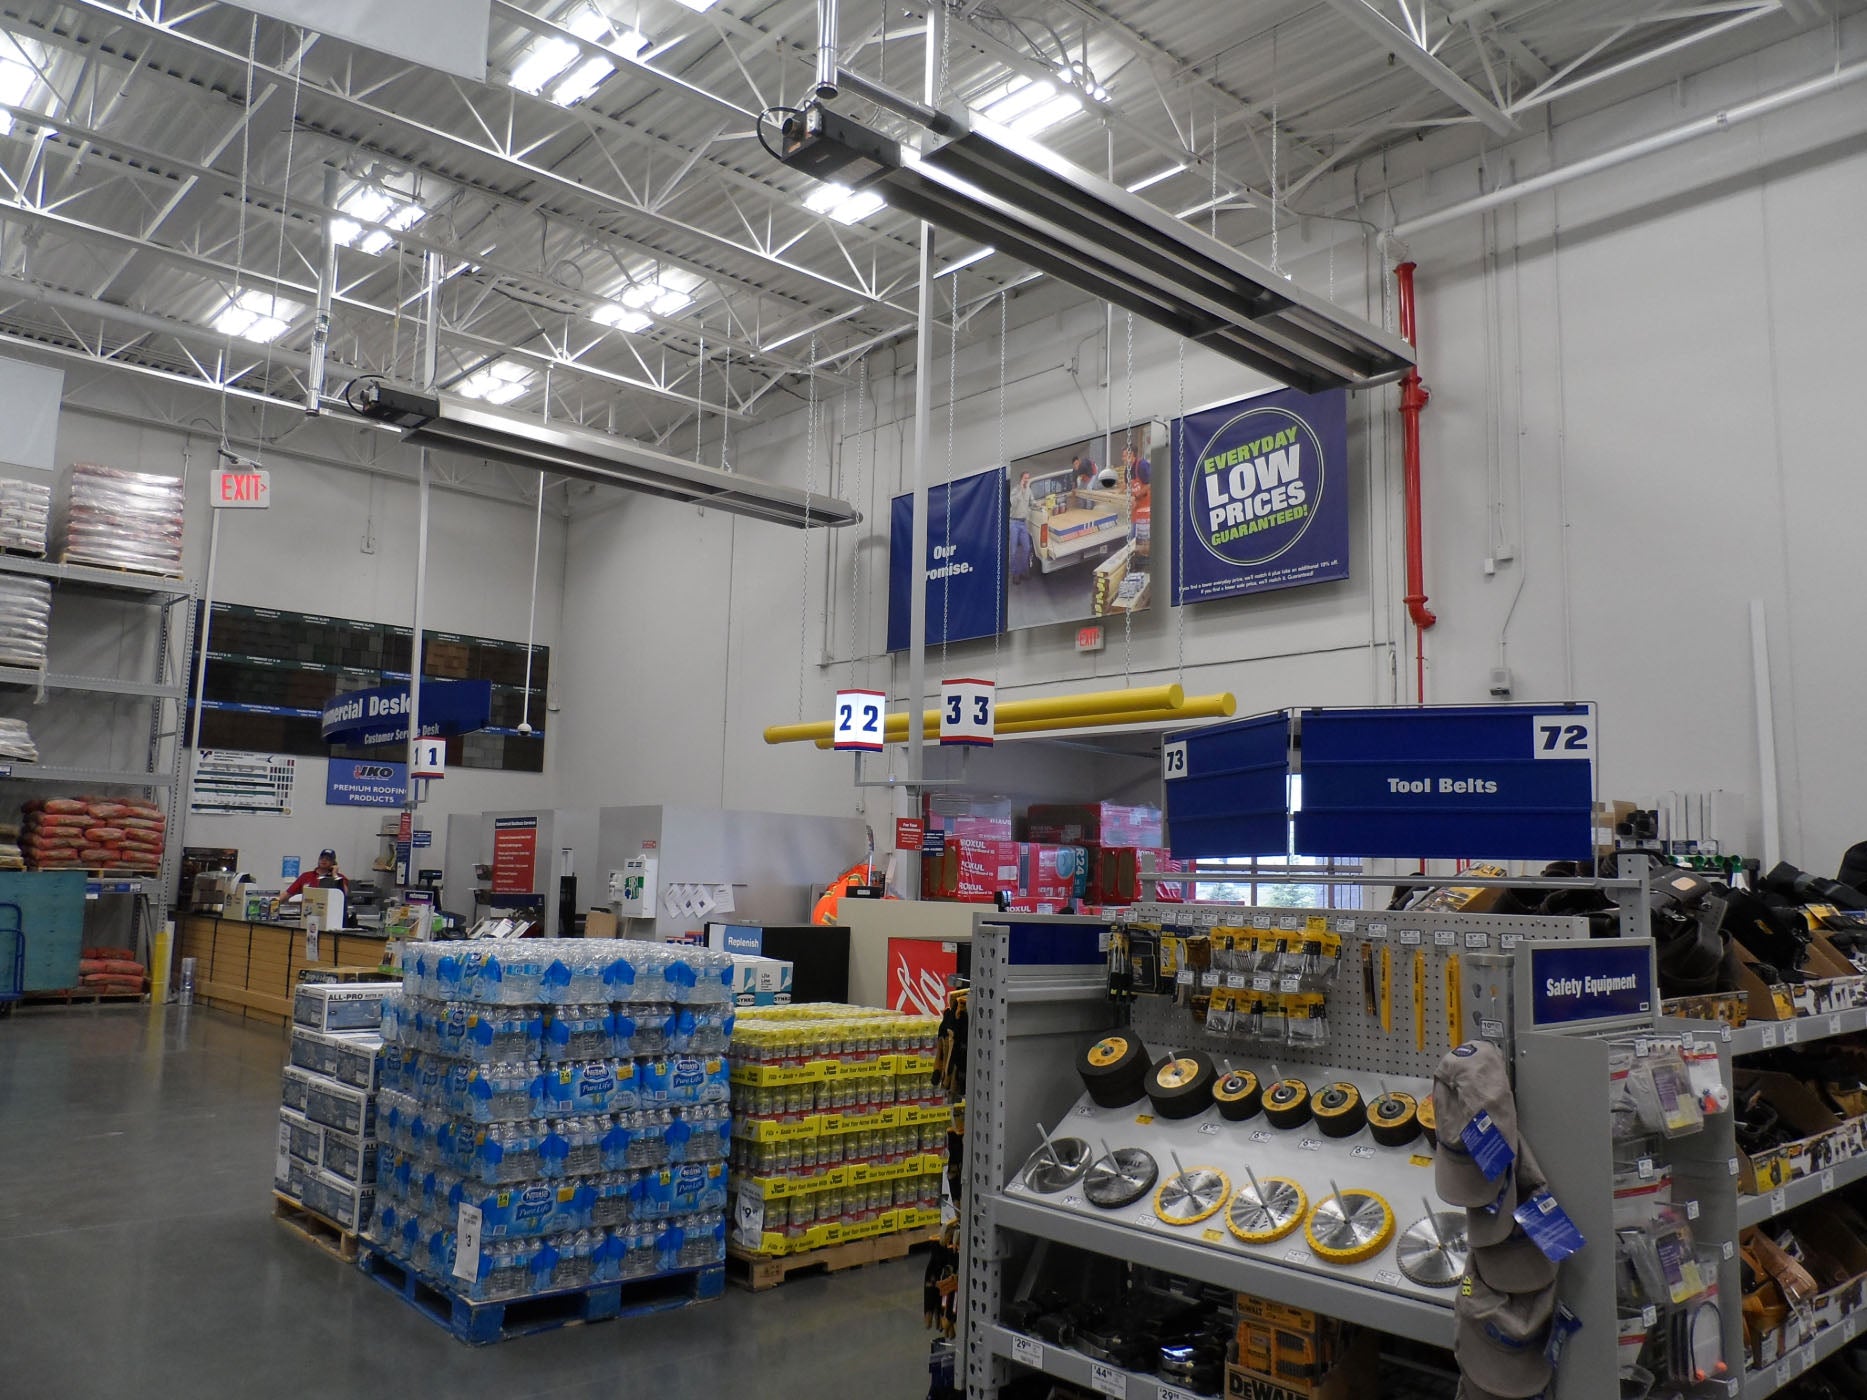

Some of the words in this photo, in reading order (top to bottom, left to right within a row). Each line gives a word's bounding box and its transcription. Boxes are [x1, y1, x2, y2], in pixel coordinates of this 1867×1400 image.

[1204, 426, 1298, 474] EVERYDAY
[221, 474, 262, 501] EXIT
[1205, 443, 1301, 508] LOW
[1210, 481, 1306, 532] PRICES
[1211, 504, 1309, 546] GUARANTEED!
[934, 544, 957, 560] Our
[925, 562, 974, 582] romise.
[369, 693, 411, 717] Desk
[946, 695, 962, 725] 3
[973, 696, 989, 726] 3
[839, 704, 852, 731] 2
[863, 705, 879, 732] 2
[364, 731, 394, 745] Customer
[422, 722, 440, 736] Desk
[1540, 725, 1589, 751] 72
[428, 747, 438, 766] 1
[1166, 749, 1185, 773] 73
[360, 766, 392, 777] IKO
[333, 783, 371, 793] PREMIUM
[373, 787, 407, 795] ROOFIN
[1387, 778, 1431, 794] Tool
[1438, 778, 1498, 794] Belts
[349, 794, 394, 803] PRODUCTS
[960, 840, 986, 848] ROXUL
[1076, 848, 1084, 875] R24
[728, 936, 759, 949] Replenish
[328, 993, 363, 1001] ALL-PRO
[1546, 978, 1583, 998] Safety
[1584, 973, 1637, 996] Equipment
[582, 1084, 597, 1092] Pure
[598, 1081, 612, 1090] Life
[1462, 1275, 1473, 1297] 48
